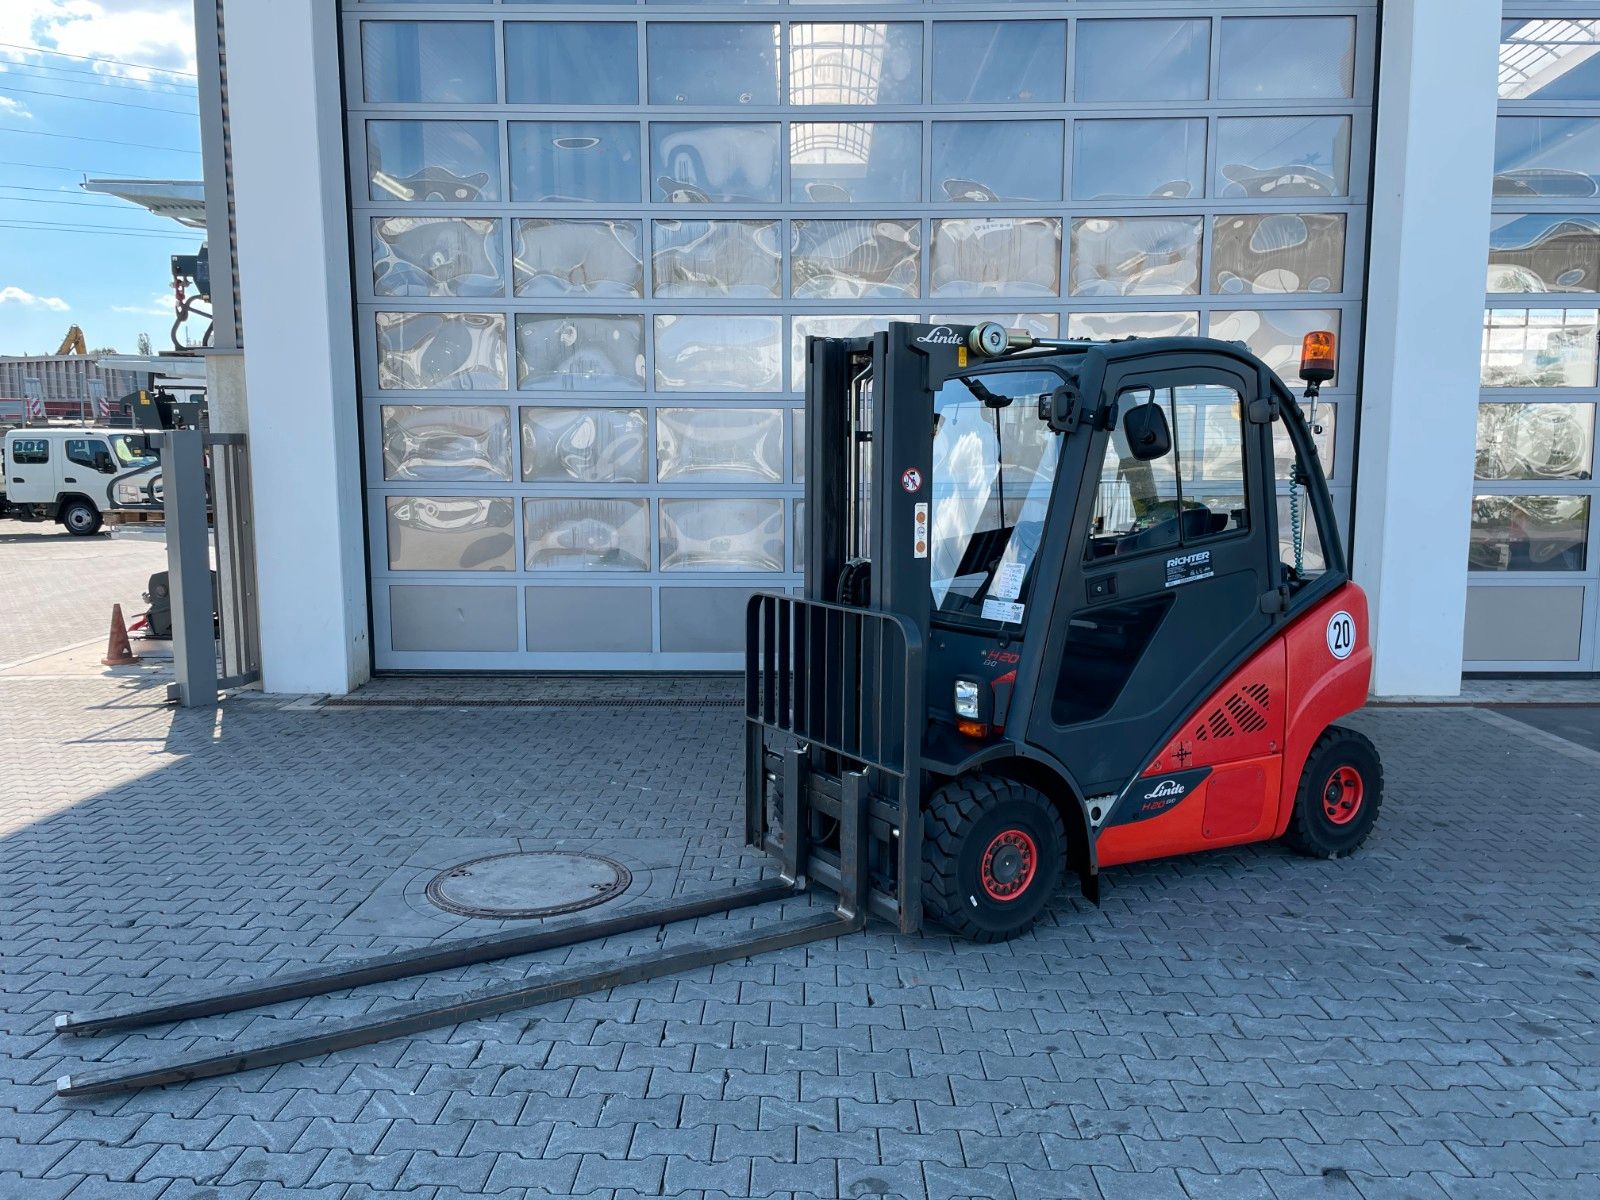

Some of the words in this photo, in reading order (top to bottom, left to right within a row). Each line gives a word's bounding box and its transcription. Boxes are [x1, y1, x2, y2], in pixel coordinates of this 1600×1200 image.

[917, 326, 963, 344] Linde
[1333, 619, 1350, 650] 20
[988, 650, 1020, 664] H20
[1144, 780, 1185, 799] Linde
